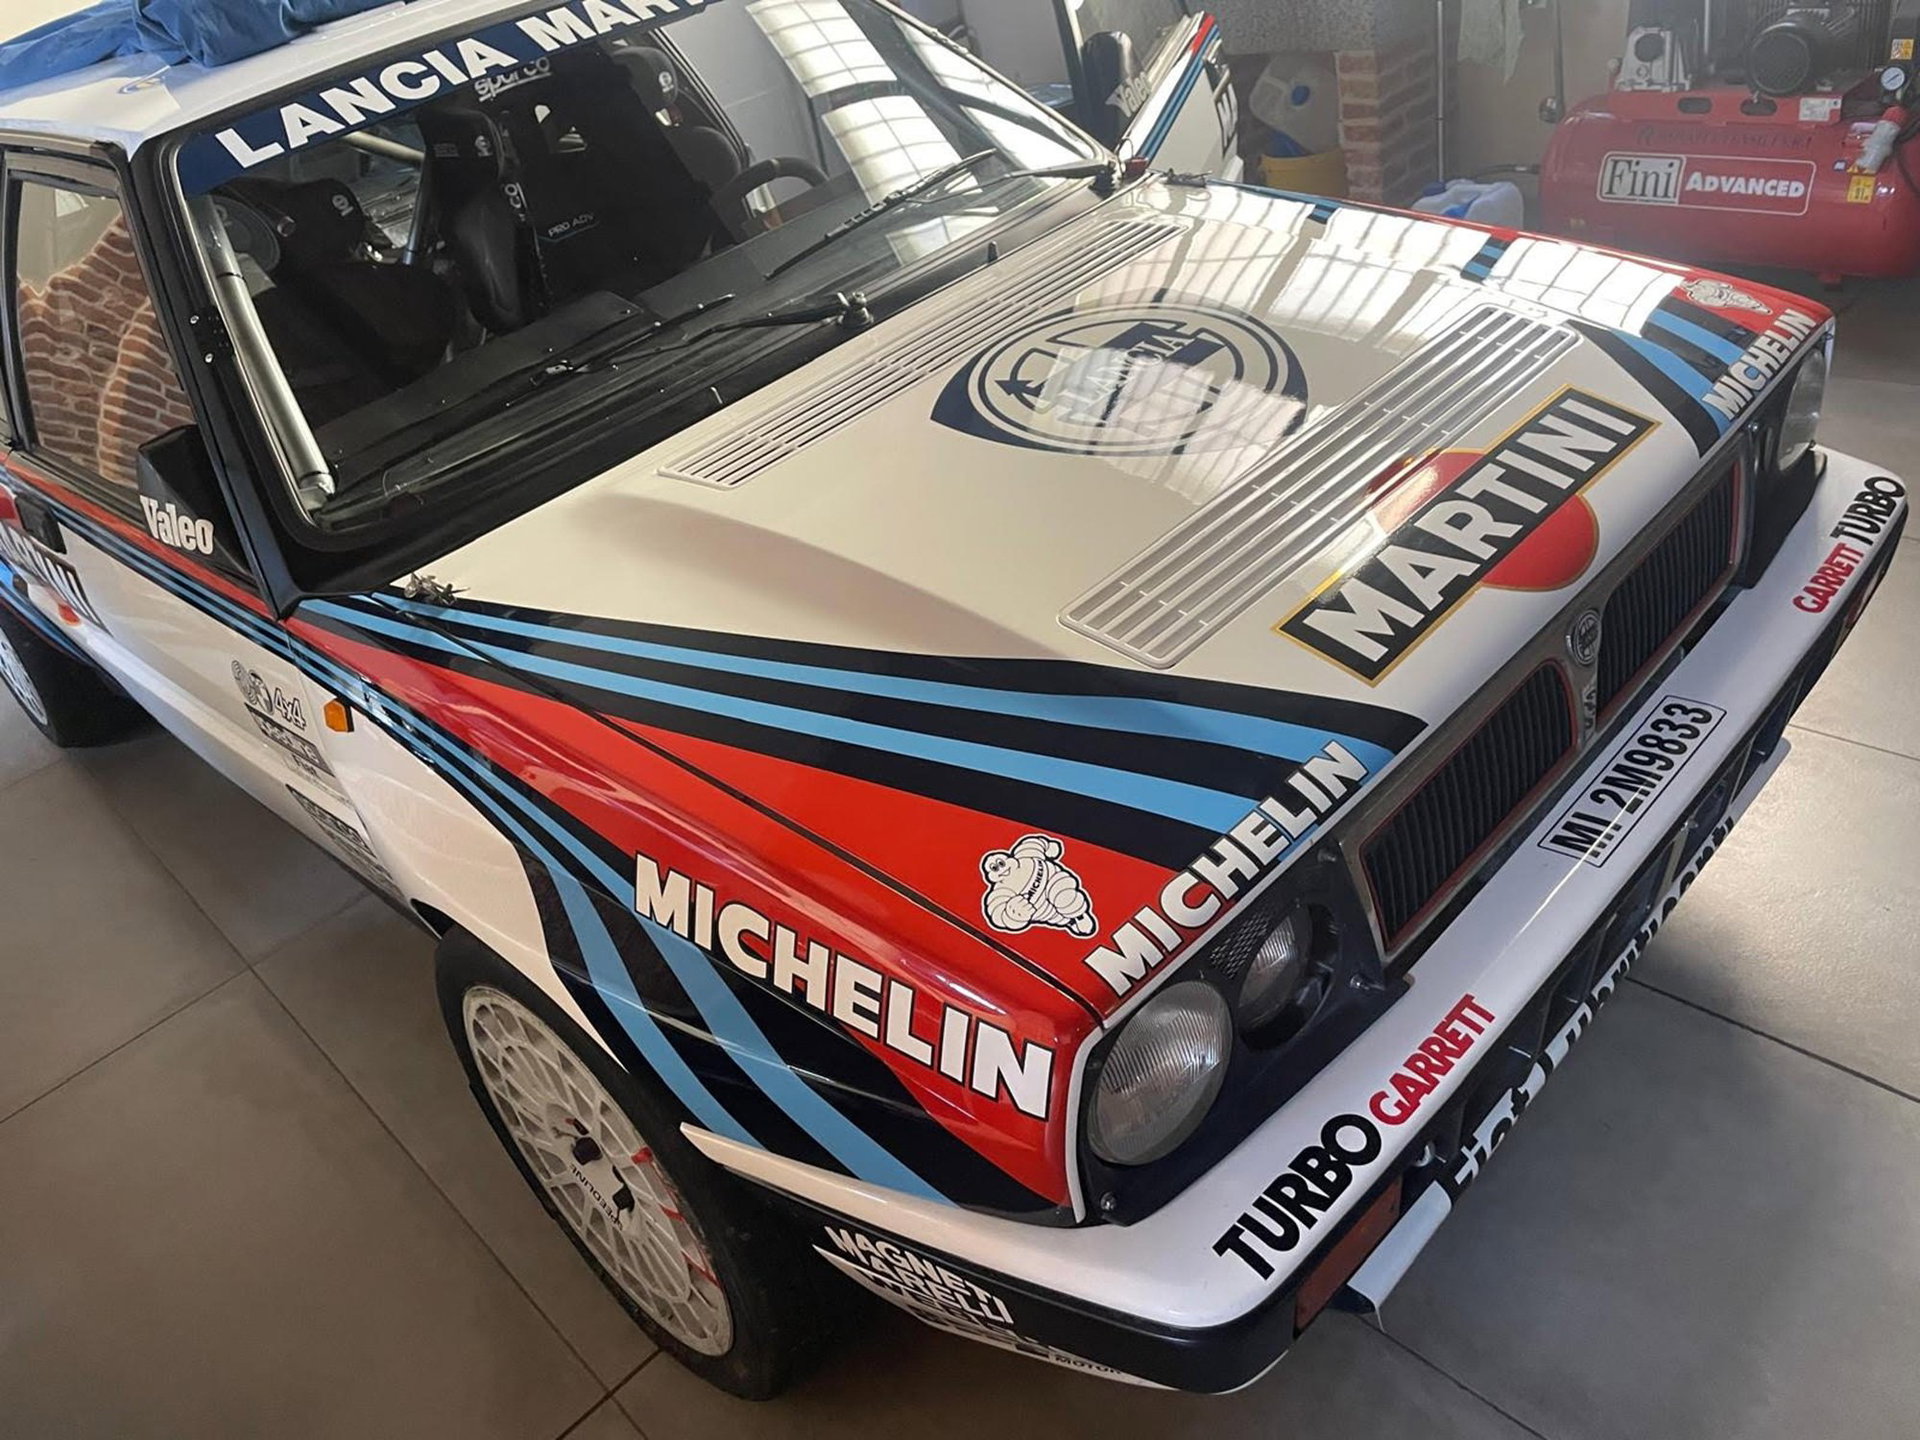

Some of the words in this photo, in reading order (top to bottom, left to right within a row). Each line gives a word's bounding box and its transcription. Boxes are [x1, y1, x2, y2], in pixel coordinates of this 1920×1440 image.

[214, 37, 518, 169] LANCIA
[515, 0, 700, 51] MAR
[1604, 158, 1679, 200] Fini
[1686, 171, 1805, 197] ADVANCED
[1702, 308, 1817, 420] MICHELIN
[140, 495, 214, 555] Valeo
[1302, 400, 1637, 662] MARTINI
[1792, 542, 1865, 613] GARRETT
[1830, 477, 1905, 546] TURBO
[274, 687, 307, 731] 4x4
[1550, 811, 1622, 858] MI
[1590, 703, 1712, 814] 2M9833
[1086, 740, 1364, 998] MICHELIN
[634, 852, 1053, 1120] MICHELIN
[1213, 1114, 1381, 1281] TURBO
[1368, 994, 1496, 1126] GARRETT
[824, 1226, 1014, 1324] MAGNETI
